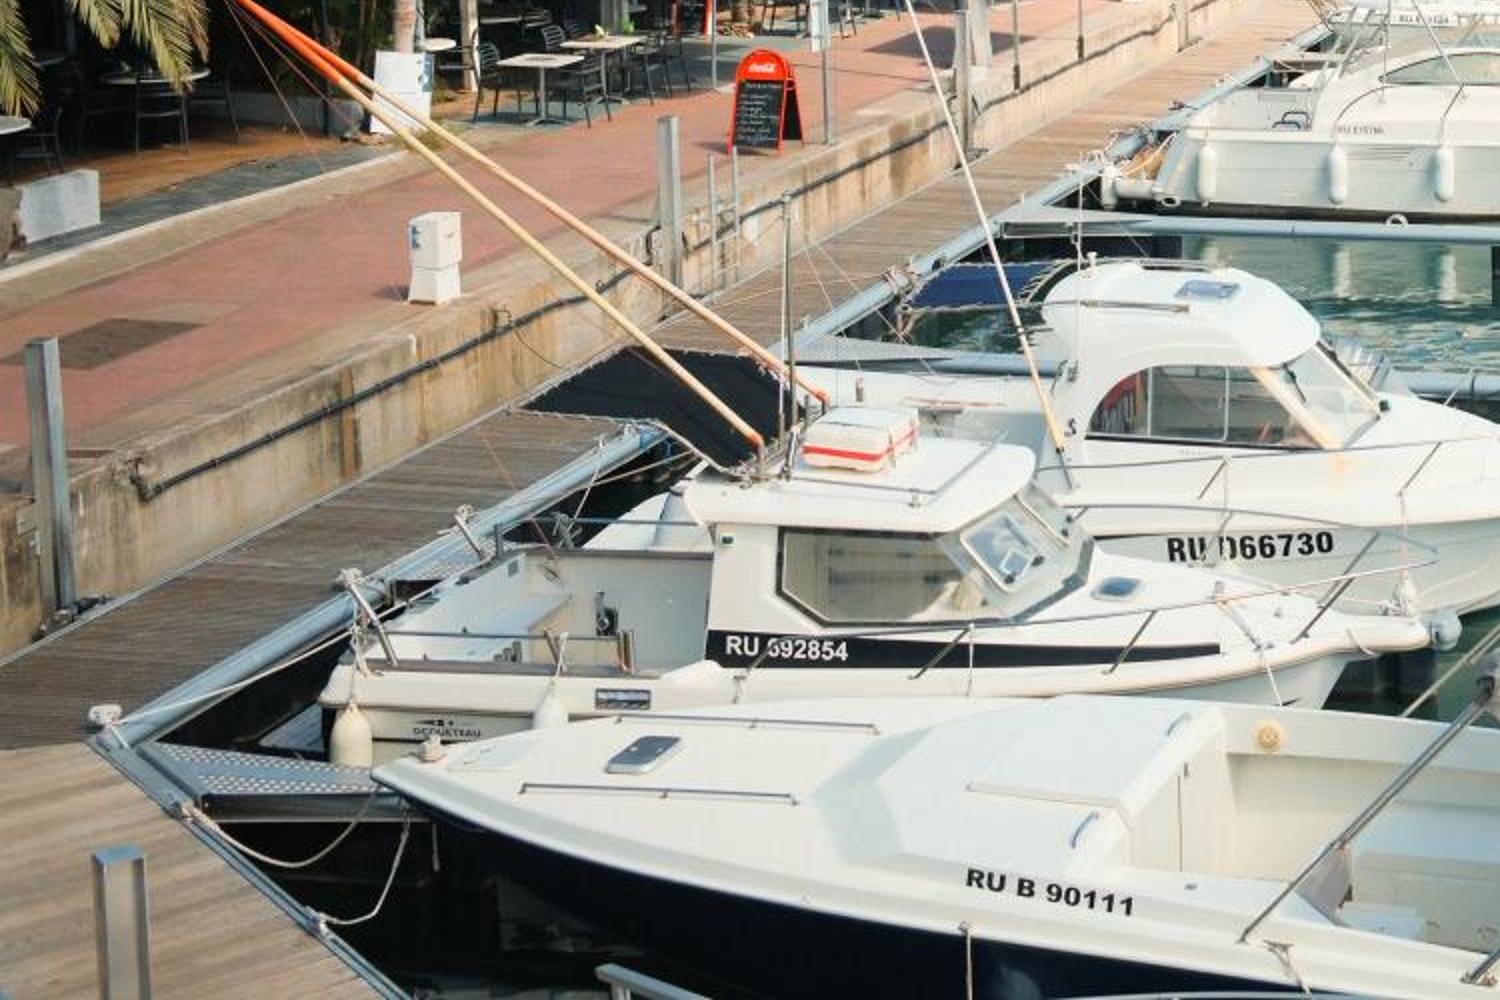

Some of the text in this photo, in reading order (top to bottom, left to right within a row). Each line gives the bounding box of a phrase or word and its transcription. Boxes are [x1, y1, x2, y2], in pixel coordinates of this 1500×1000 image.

[1167, 537, 1206, 562] RU
[726, 635, 848, 661] RU 692854
[966, 868, 1134, 917] RU B 90111
